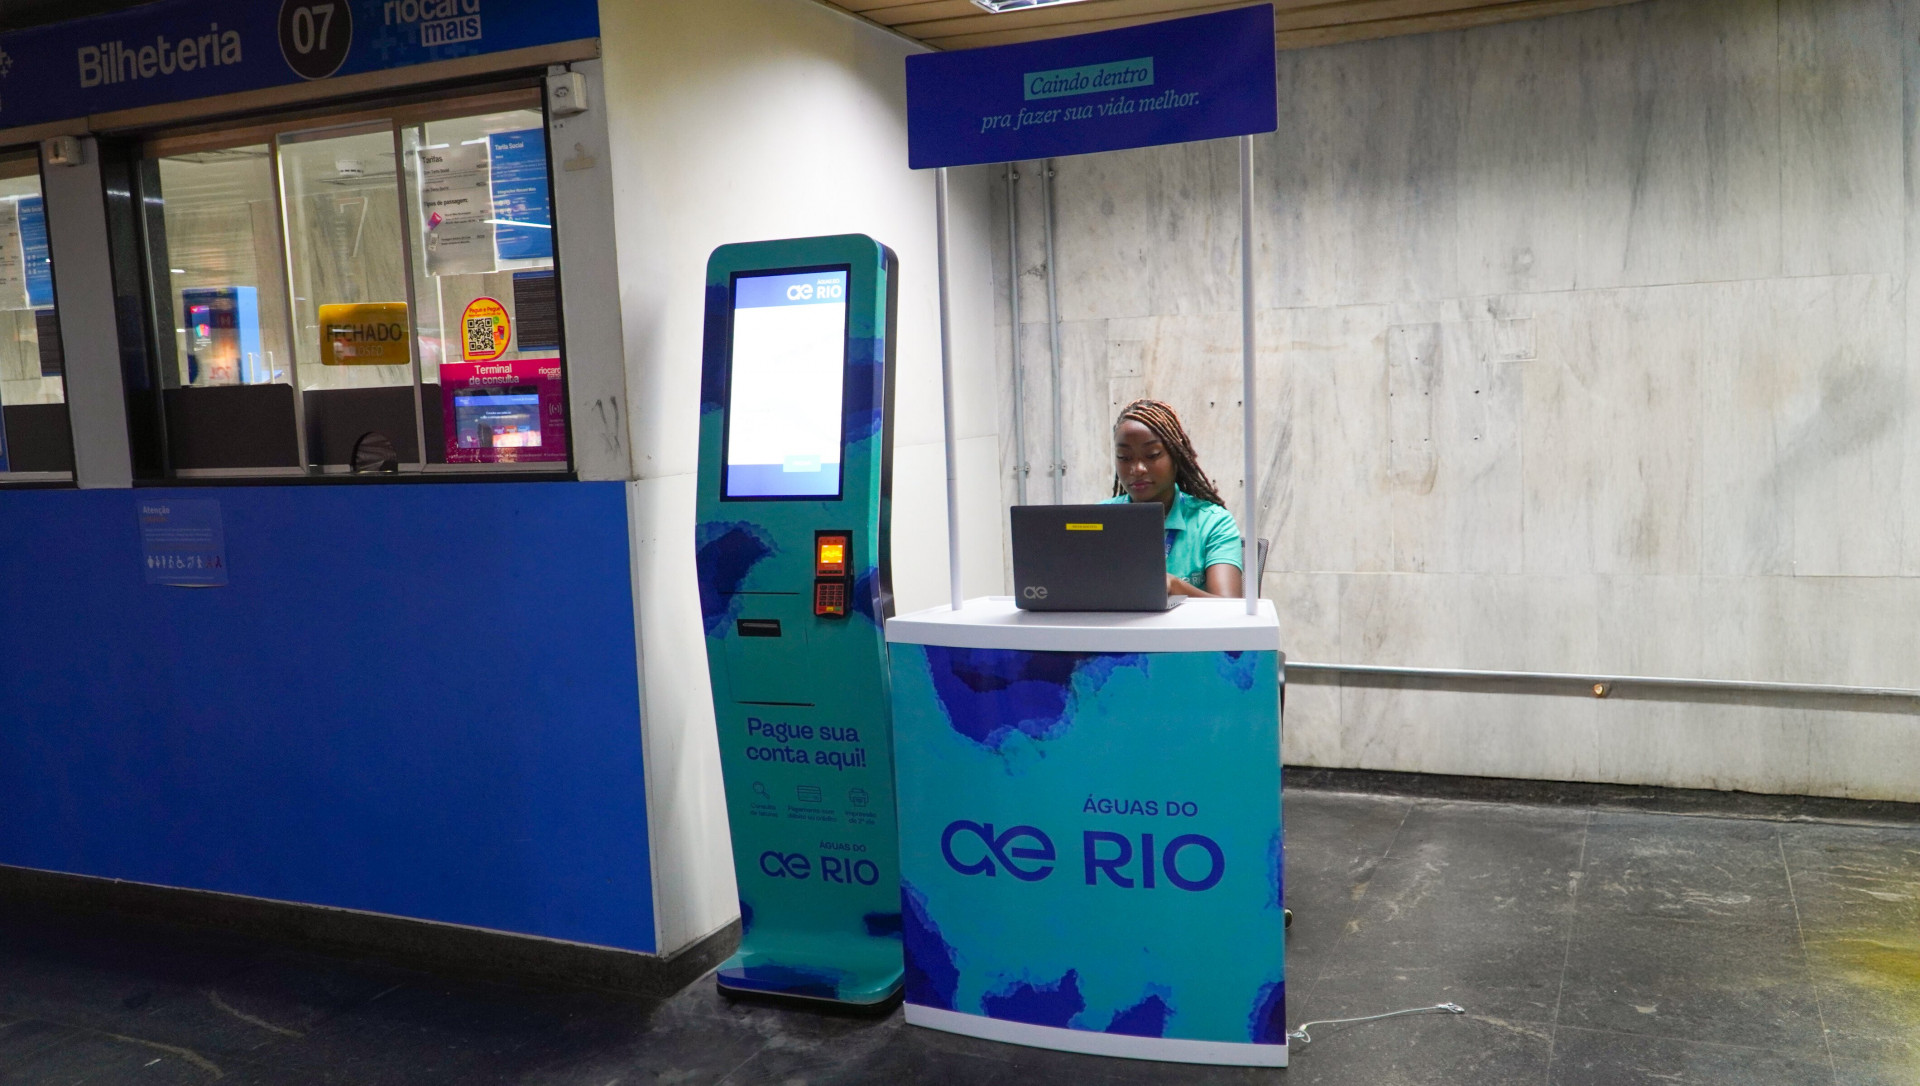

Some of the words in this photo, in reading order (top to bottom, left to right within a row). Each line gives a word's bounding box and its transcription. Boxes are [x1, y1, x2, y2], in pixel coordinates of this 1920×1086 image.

[292, 3, 335, 54] 07
[424, 18, 479, 43] mais
[78, 22, 242, 88] Bilheteria
[1030, 72, 1090, 95] Caindo
[1092, 66, 1148, 87] dentro
[981, 113, 1011, 134] pra
[1013, 108, 1061, 131] fazer
[1063, 104, 1094, 121] sua
[1098, 97, 1134, 117] vida
[1138, 89, 1200, 112] melhor.
[816, 284, 842, 299] RIO
[326, 323, 402, 342] FECHADO
[469, 376, 480, 385] de
[482, 374, 520, 385] consulta
[474, 363, 512, 375] Terminal
[143, 506, 170, 516] Atenção
[1024, 586, 1048, 599] ae
[747, 717, 814, 743] Pague
[819, 725, 860, 743] sua
[746, 745, 810, 764] conta
[815, 748, 867, 771] aqui!
[1082, 793, 1159, 816] ÁGUAS
[1166, 801, 1198, 817] DO
[819, 840, 851, 851] ÁGUAS
[852, 843, 866, 852] DO
[940, 819, 1056, 882] ae
[1082, 830, 1226, 892] RIO
[759, 850, 811, 880] ae
[820, 856, 880, 886] RIO
